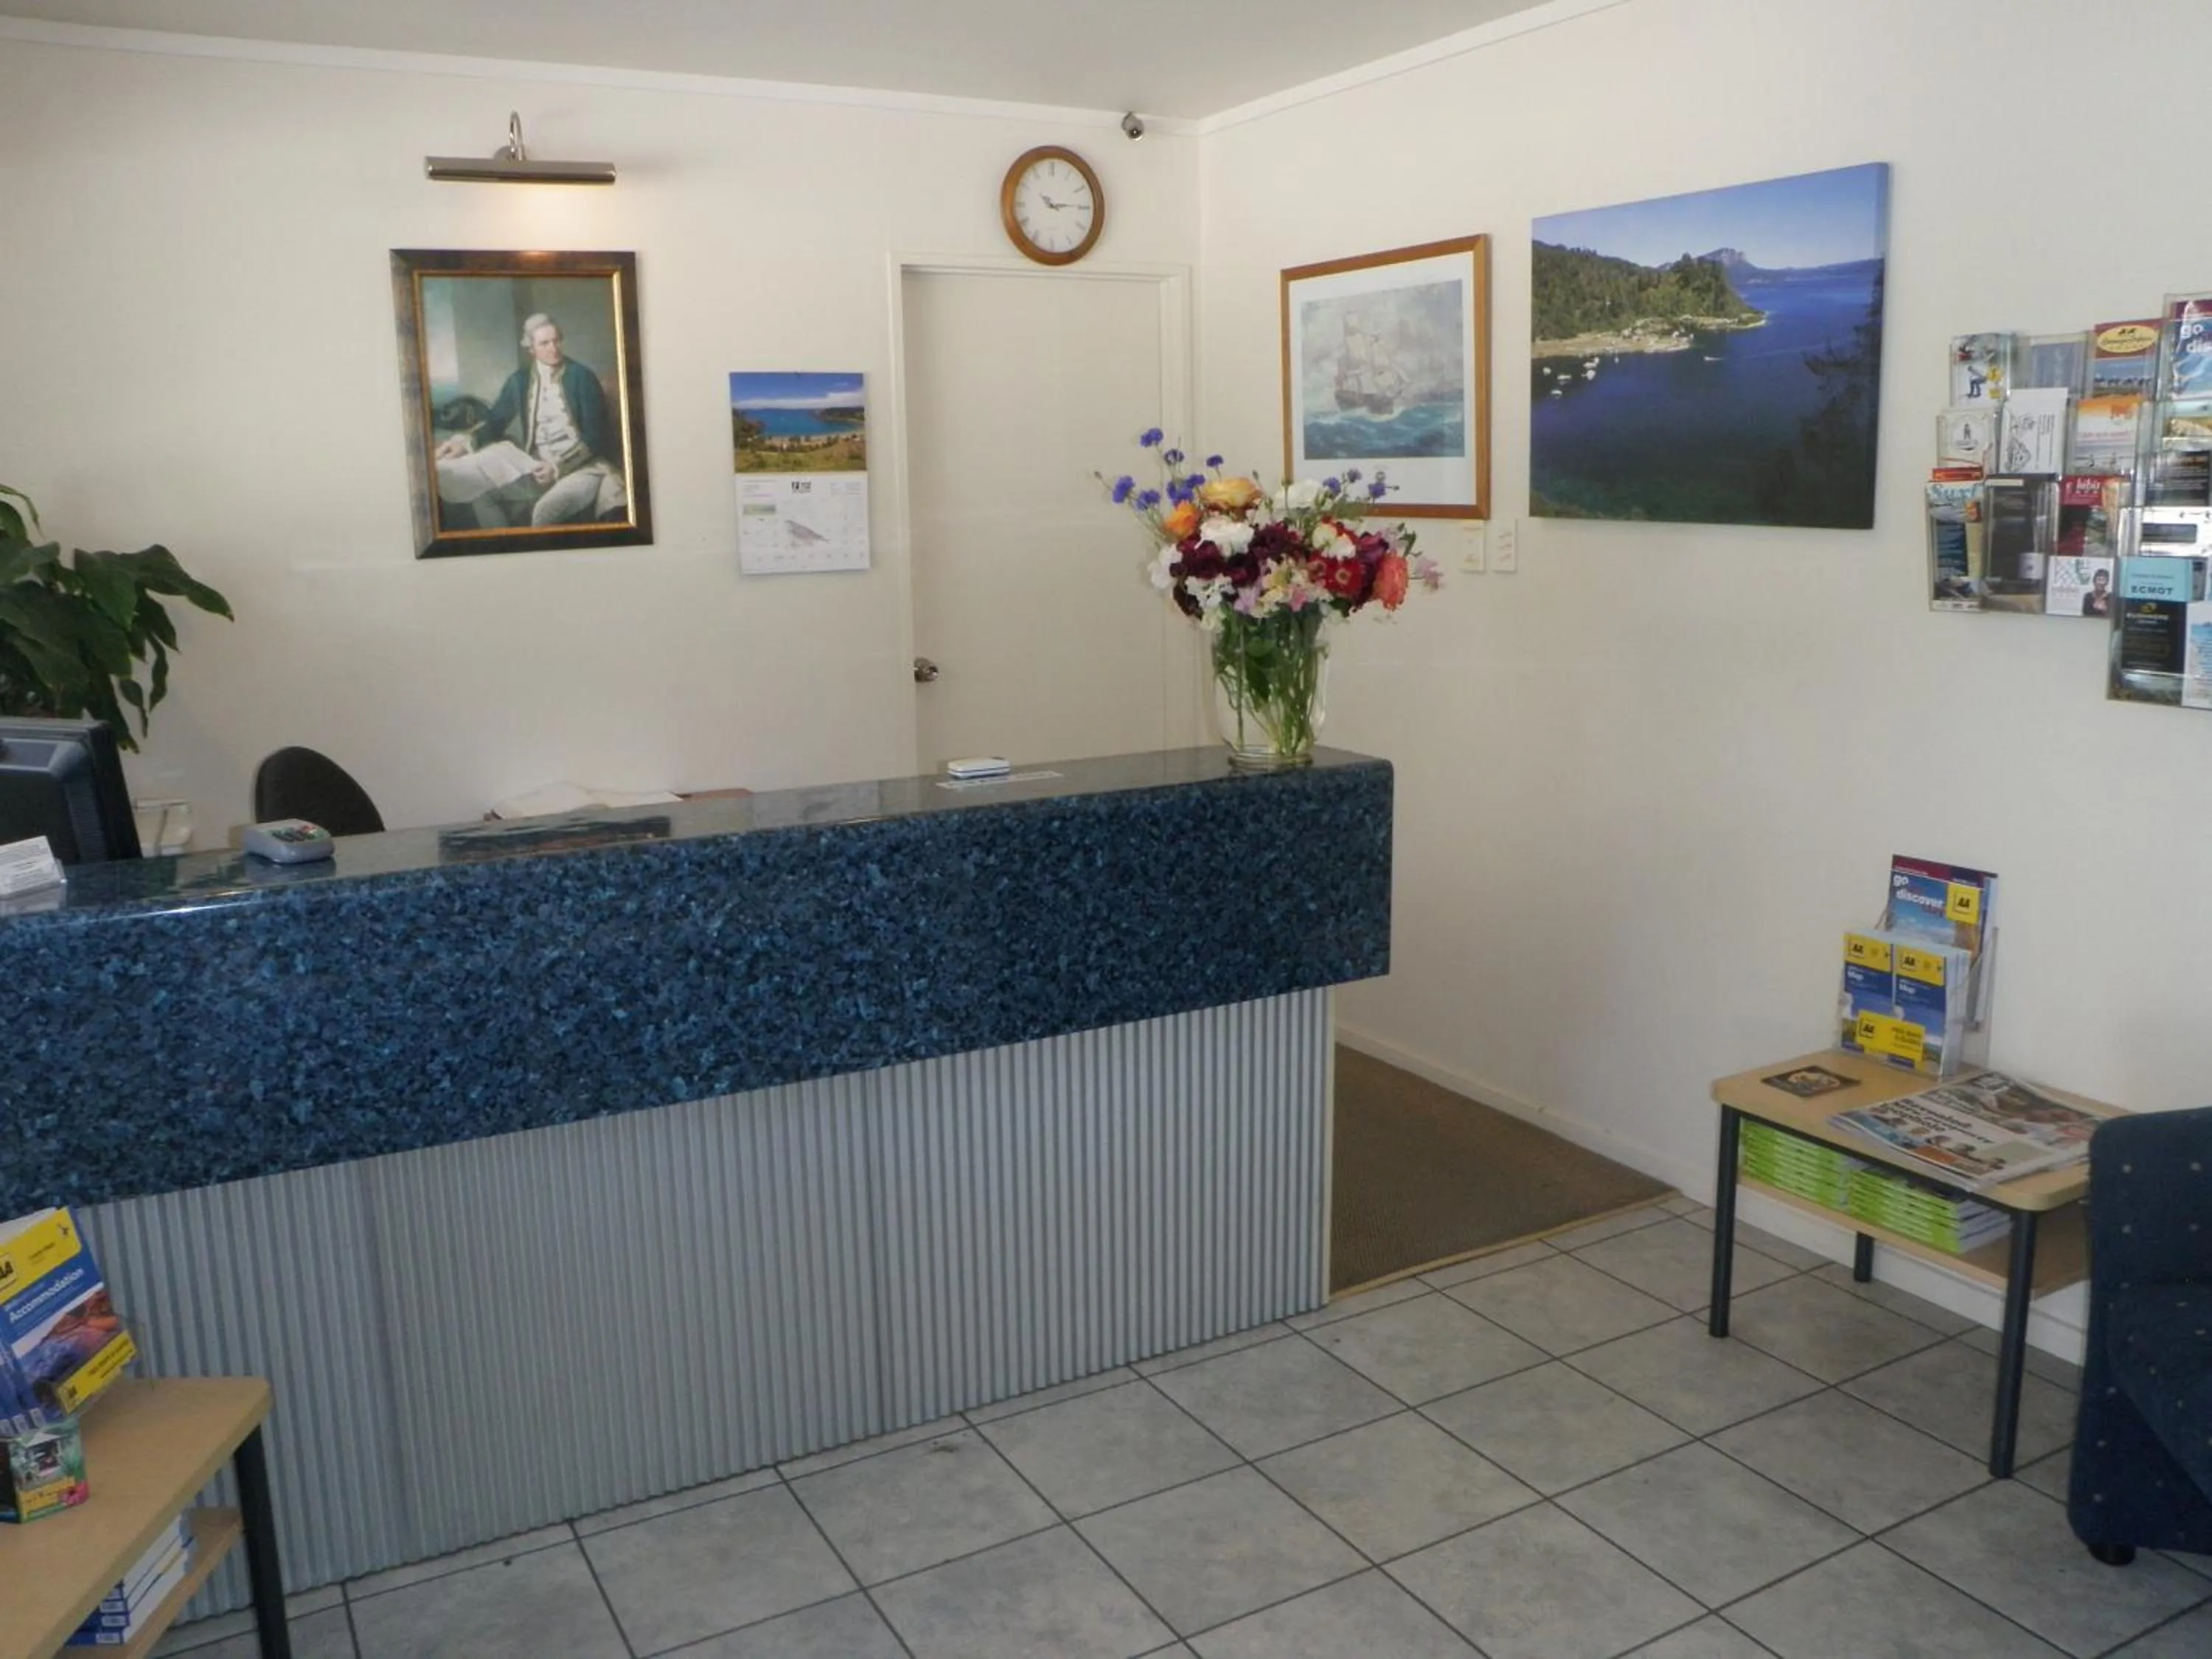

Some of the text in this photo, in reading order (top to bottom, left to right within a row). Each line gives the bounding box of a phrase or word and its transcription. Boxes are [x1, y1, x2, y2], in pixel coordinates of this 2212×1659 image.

[2180, 324, 2204, 340] go
[1893, 874, 1909, 887] go
[1896, 888, 1944, 908] discover
[9, 1267, 84, 1325] Accommodation
